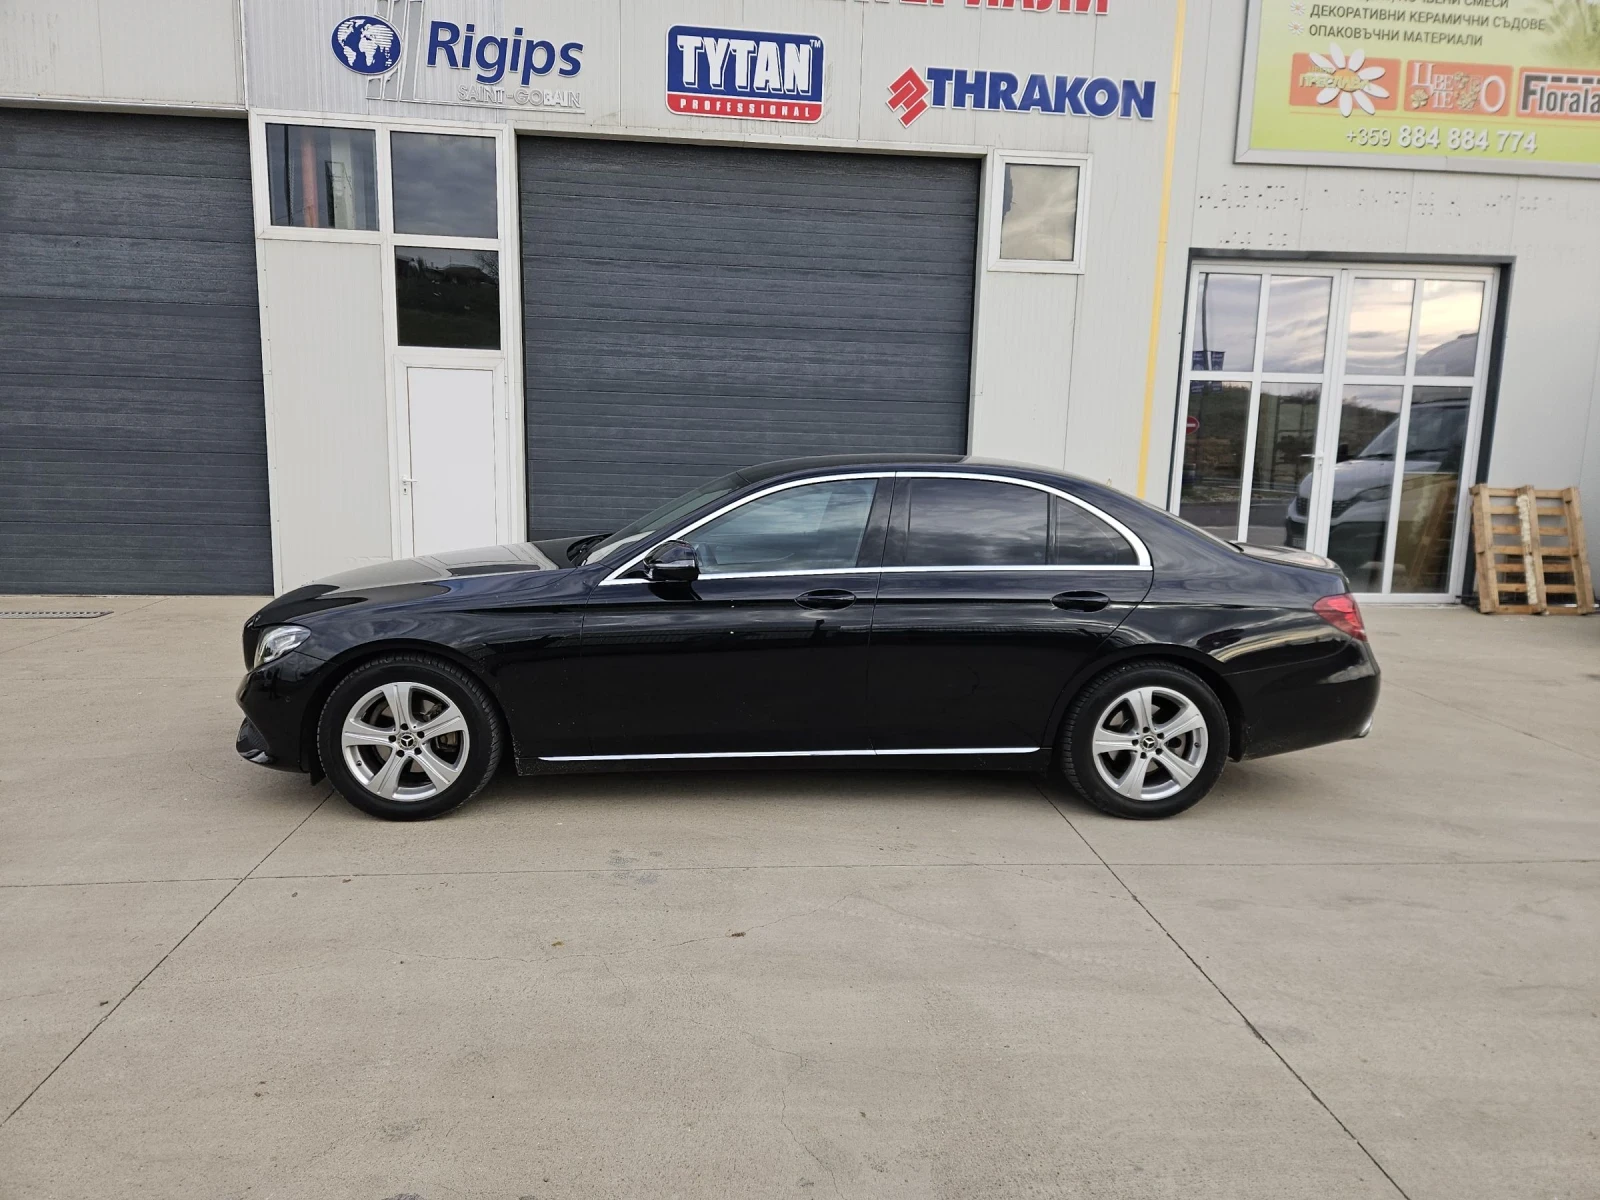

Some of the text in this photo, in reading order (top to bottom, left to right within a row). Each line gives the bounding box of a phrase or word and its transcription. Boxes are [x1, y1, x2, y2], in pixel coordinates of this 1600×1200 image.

[1310, 4, 1546, 32] ДЕКОРАТИВНИ КЕРАМИЧНИ СЪДОВЕ
[1309, 24, 1483, 46] ОПАКОВЪЧНИ МАТЕРИАЛИ
[427, 21, 584, 86] Rigips
[677, 35, 813, 94] TYTAN
[458, 84, 581, 108] SAINT-GOBAIN
[926, 66, 1157, 120] THRAKON
[679, 98, 810, 118] PROFESSIONAL
[1346, 126, 1538, 154] +359 884 884 774
